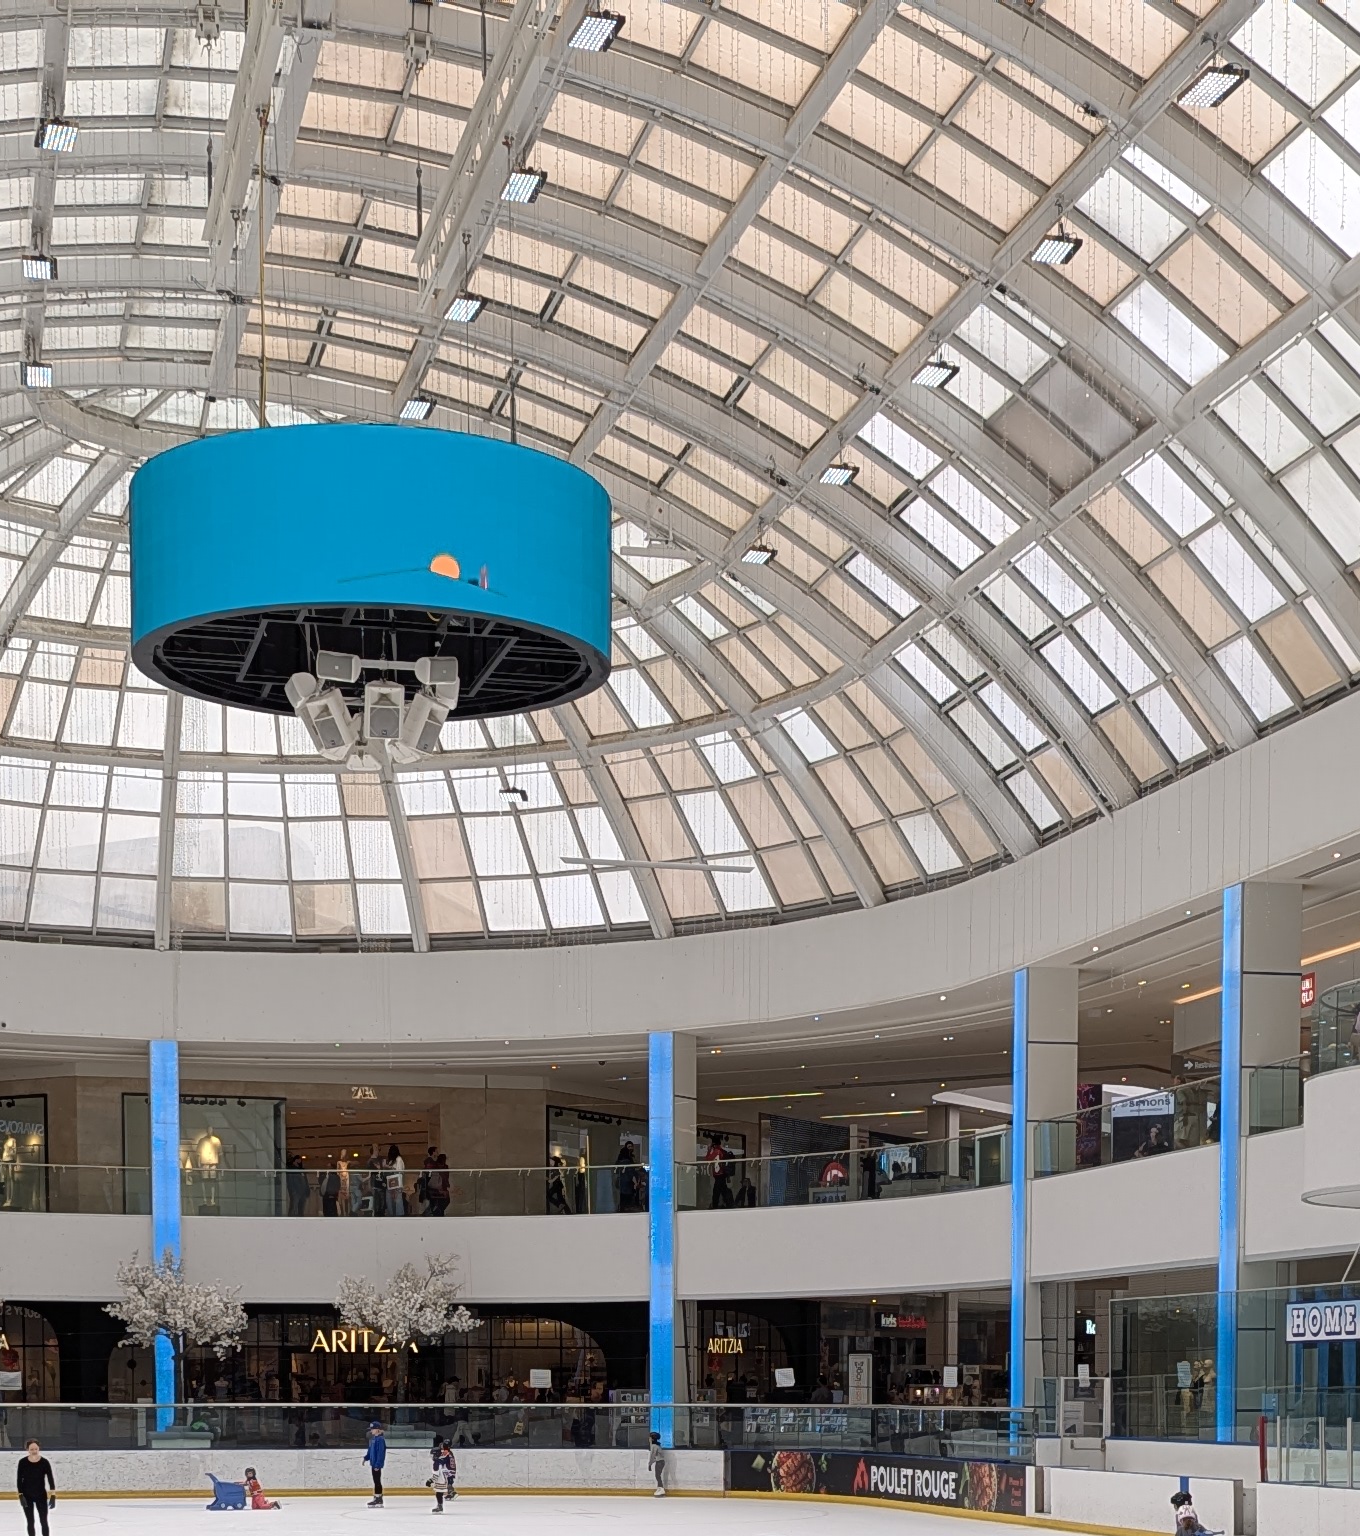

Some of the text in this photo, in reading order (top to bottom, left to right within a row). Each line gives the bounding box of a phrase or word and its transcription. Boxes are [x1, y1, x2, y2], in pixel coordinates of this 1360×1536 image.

[1291, 1304, 1357, 1337] HOME
[707, 1337, 743, 1354] ARITZIA
[870, 1465, 957, 1500] POULET ROUGE
